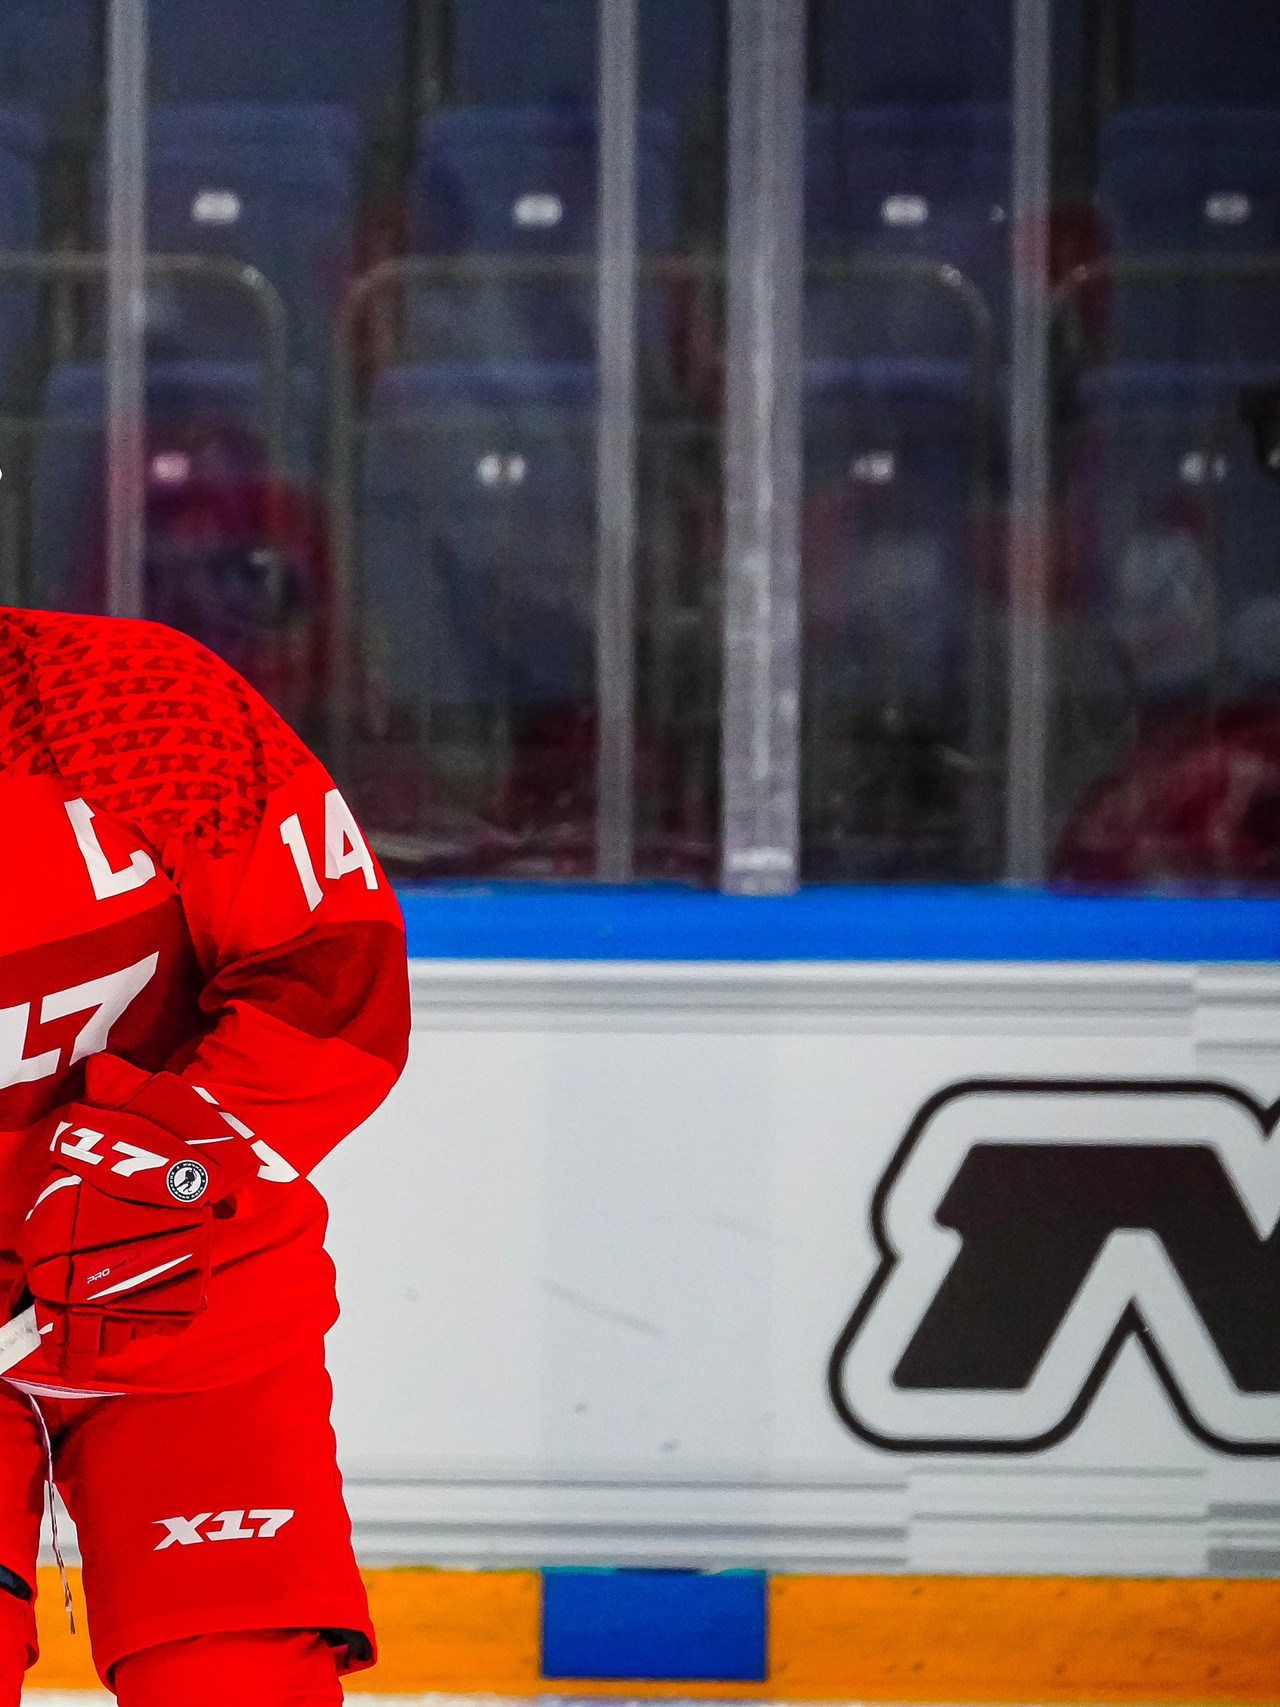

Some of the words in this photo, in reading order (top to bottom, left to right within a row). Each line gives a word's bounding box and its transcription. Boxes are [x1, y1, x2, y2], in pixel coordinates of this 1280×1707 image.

[280, 789, 378, 912] 14
[86, 1268, 110, 1285] PRO
[151, 1509, 295, 1551] X17
